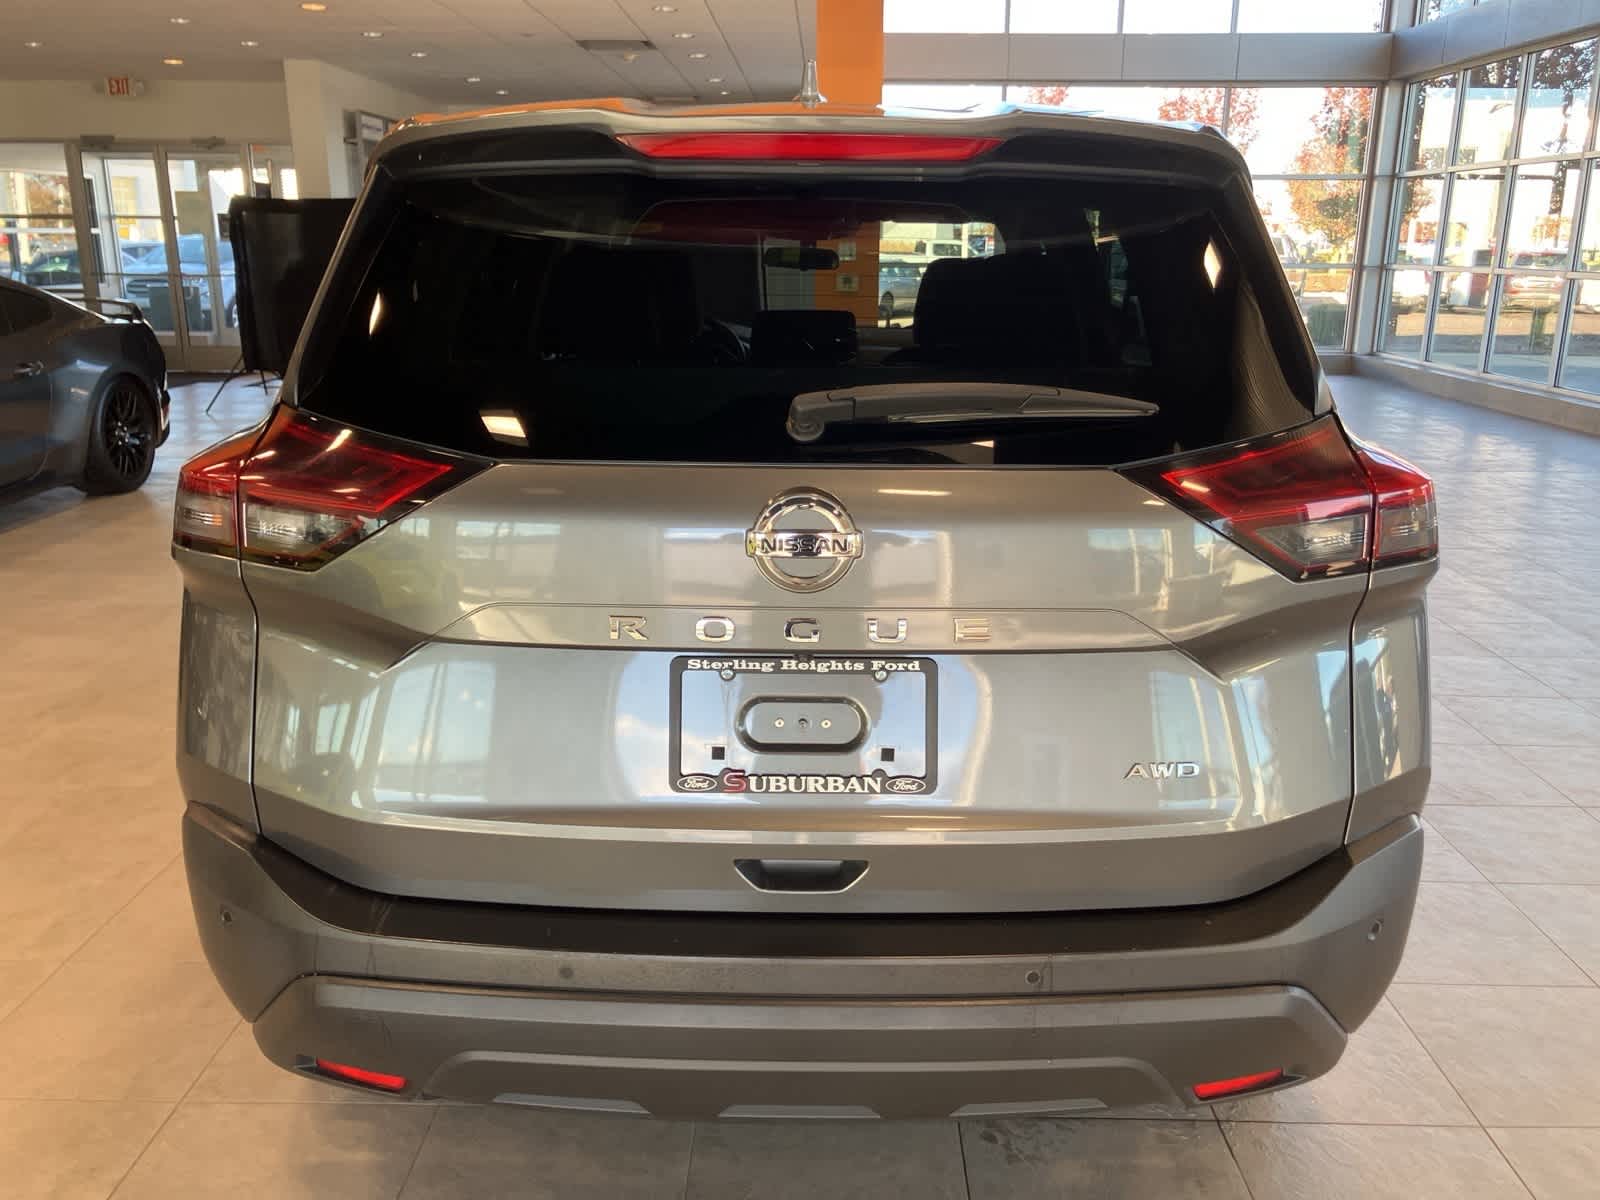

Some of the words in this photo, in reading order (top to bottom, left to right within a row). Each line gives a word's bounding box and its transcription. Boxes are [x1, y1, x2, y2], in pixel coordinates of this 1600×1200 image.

[107, 78, 130, 97] EXIT
[760, 536, 849, 553] NISSAN
[608, 614, 993, 643] ROGUE
[687, 659, 776, 673] Sterling
[780, 659, 865, 673] Heights
[871, 660, 921, 671] Ford
[1123, 761, 1200, 779] AWD
[723, 772, 883, 793] SUBURBAN
